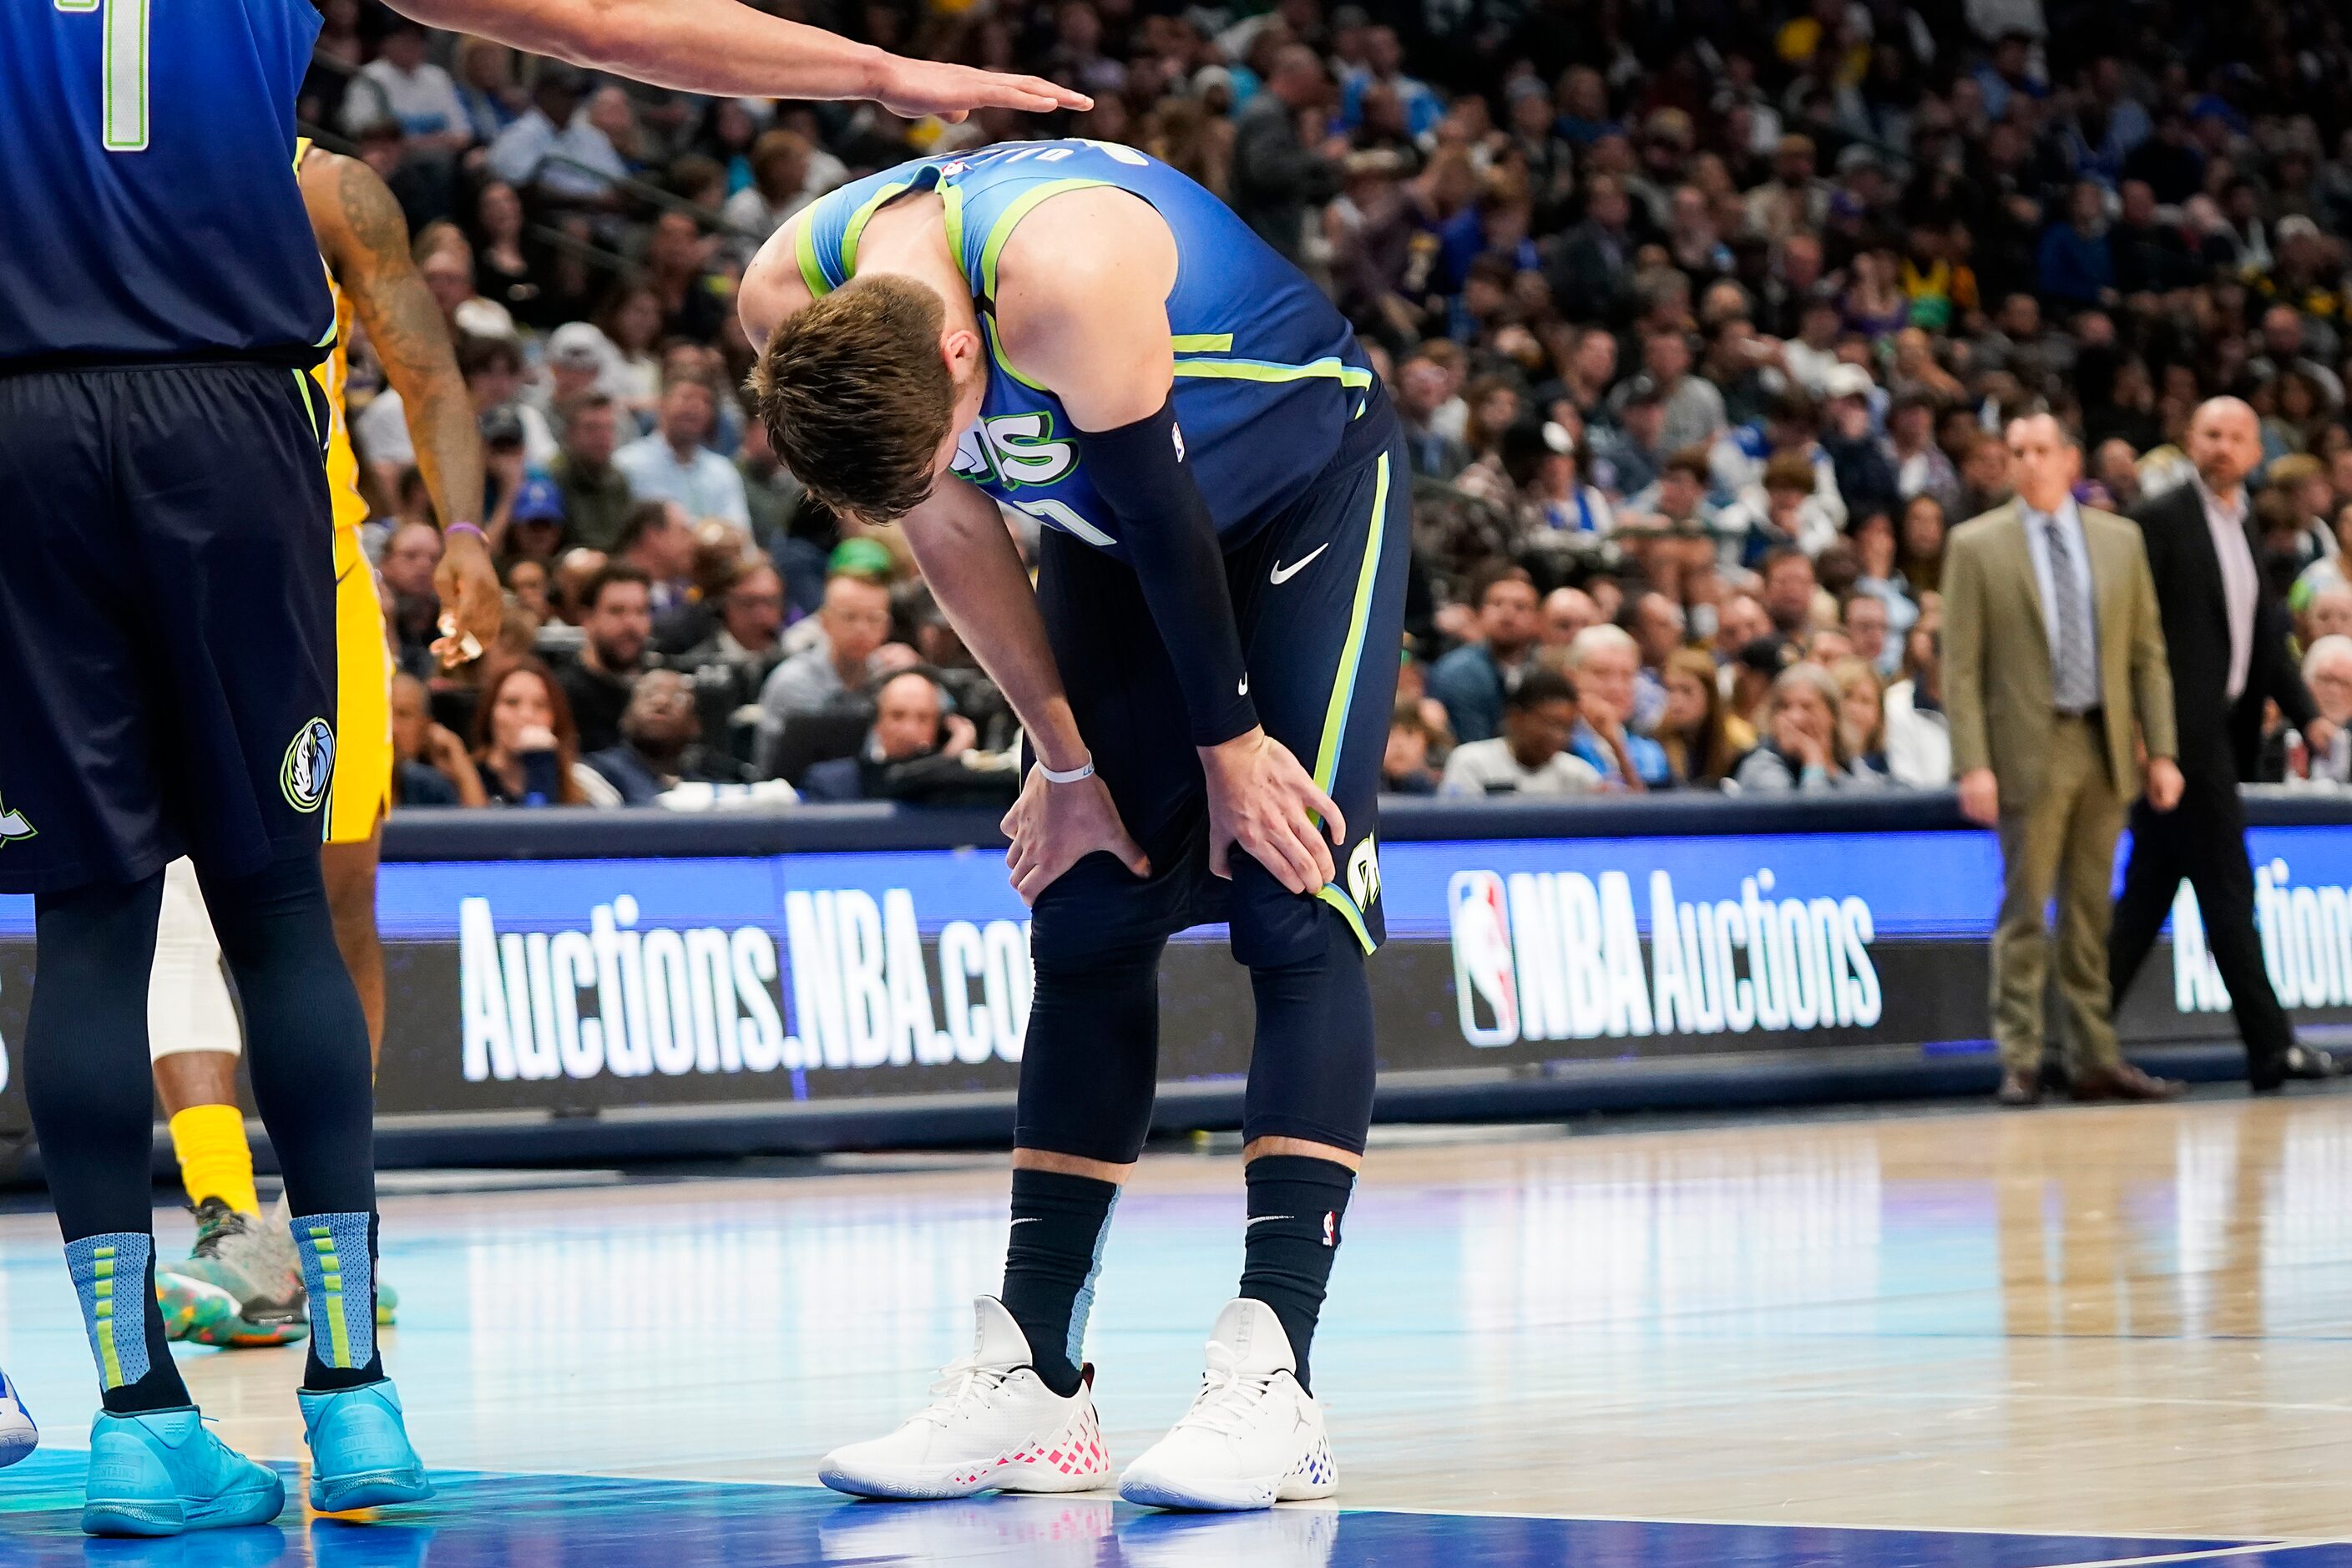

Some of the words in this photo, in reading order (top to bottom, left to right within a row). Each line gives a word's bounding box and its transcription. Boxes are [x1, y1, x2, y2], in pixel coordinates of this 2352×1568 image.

[458, 887, 1036, 1083] Auctions.NBA.co
[1508, 870, 1655, 1041] NBA
[1649, 867, 1883, 1036] Auctions
